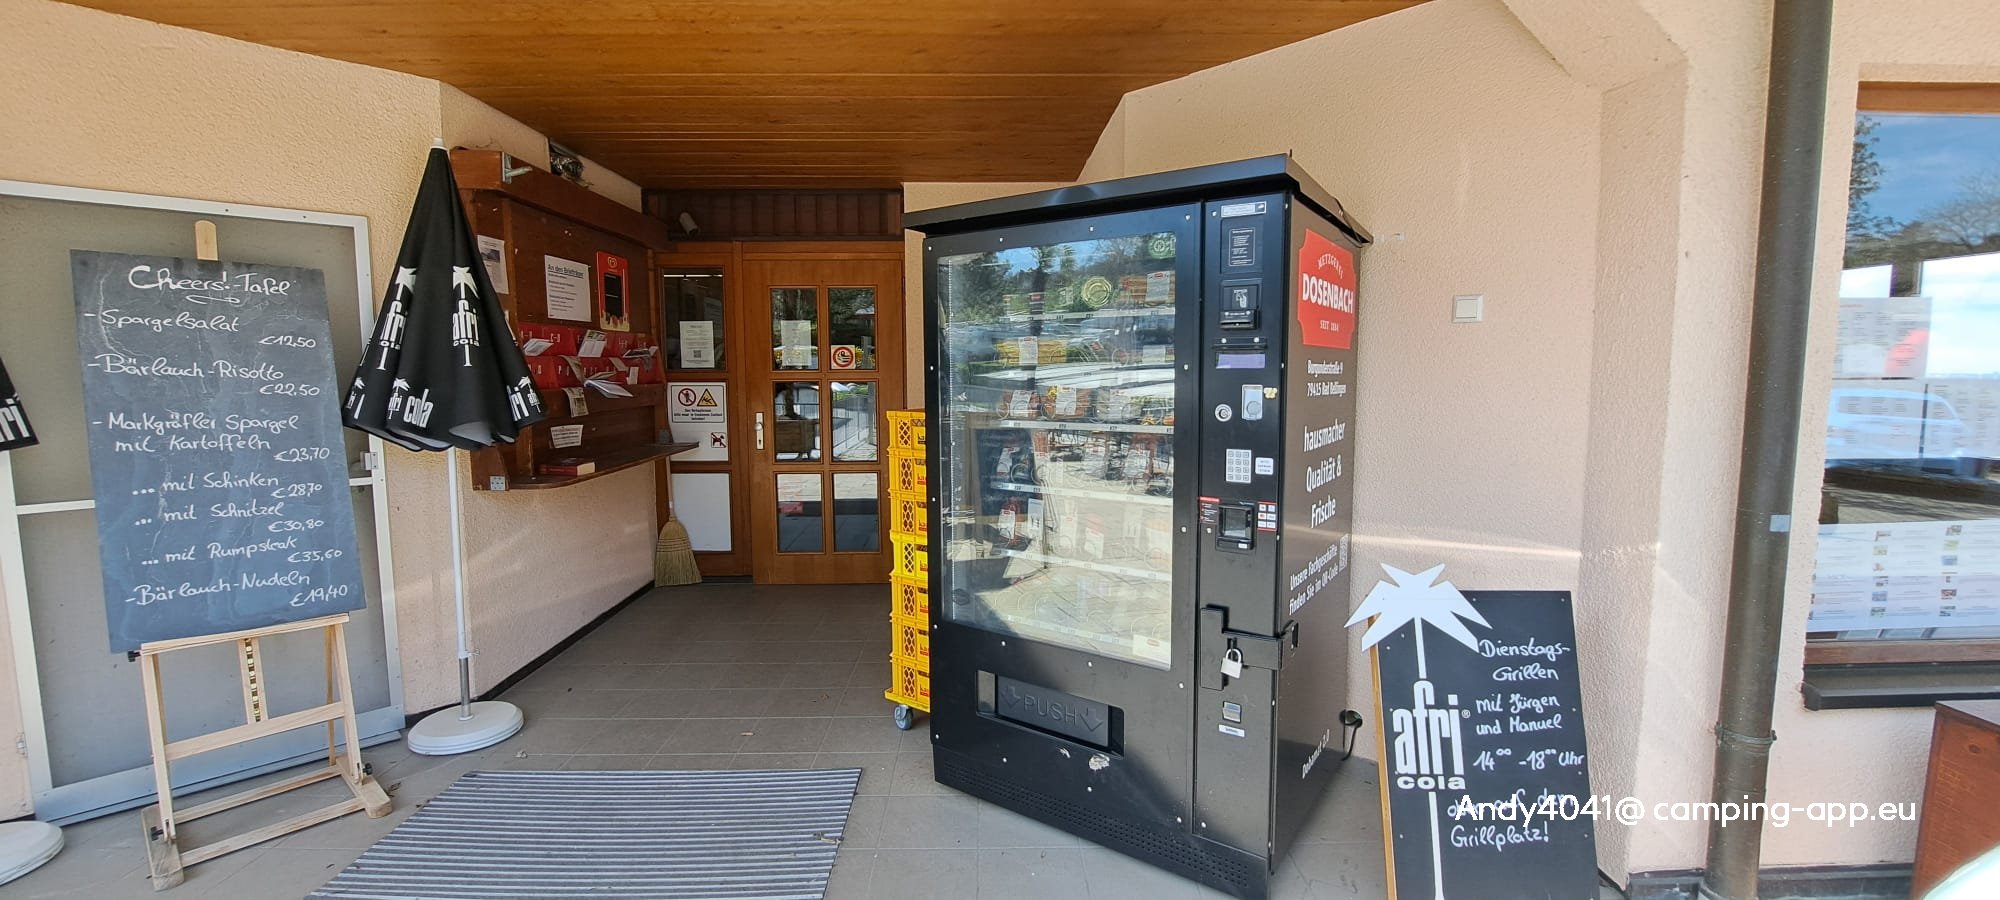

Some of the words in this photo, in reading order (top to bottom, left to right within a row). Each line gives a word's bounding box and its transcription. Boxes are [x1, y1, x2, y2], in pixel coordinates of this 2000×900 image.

[1302, 273, 1354, 314] DOSENBACH
[453, 299, 479, 340] afri
[403, 388, 434, 428] cola
[225, 415, 299, 434] Spargel
[1304, 418, 1346, 452] hausmacher
[116, 435, 155, 453] mit
[169, 434, 271, 451] Kartoffeln
[273, 447, 330, 463] €23,70
[162, 473, 196, 491] mit
[203, 472, 279, 489] Schinken
[1306, 456, 1336, 493] Qualität
[1336, 454, 1342, 478] &
[164, 505, 198, 522] mit
[210, 499, 285, 517] Schnitzel
[1311, 494, 1336, 529] Frische
[165, 545, 196, 562] mit
[207, 536, 298, 559] Rumpsteak
[287, 549, 343, 563] €35,60
[1290, 568, 1308, 591] Unsere
[1308, 544, 1338, 577] Fachgeschäfte
[289, 584, 349, 607] €19,40
[1307, 583, 1315, 601] Sie
[1479, 637, 1571, 661] Dienstags-
[1493, 663, 1559, 681] Grillen
[1024, 694, 1077, 726] PUSH
[1476, 693, 1503, 714] mit
[1509, 693, 1560, 714] Jürgen
[1392, 680, 1464, 775] afri
[1476, 719, 1502, 735] und
[1509, 714, 1562, 733] Manuel
[1558, 751, 1585, 766] Uhr
[1397, 776, 1466, 790] cola
[1450, 820, 1549, 851] Grillplatz!
